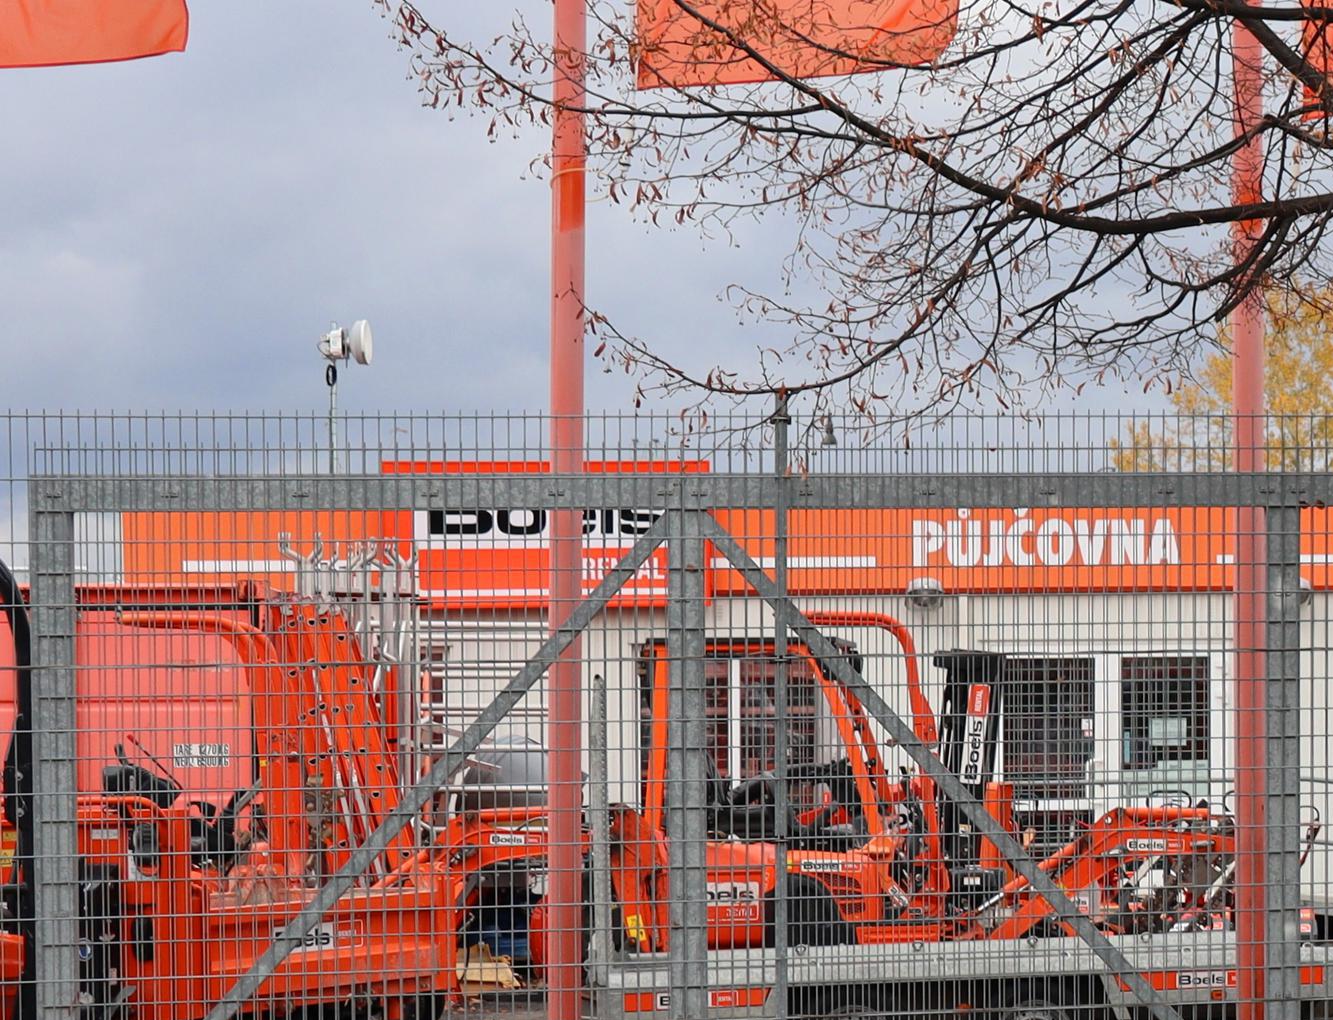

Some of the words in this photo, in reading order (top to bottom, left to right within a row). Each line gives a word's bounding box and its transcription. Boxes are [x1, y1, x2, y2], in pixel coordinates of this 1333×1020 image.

[912, 507, 1181, 566] PŮJČOVNA
[582, 557, 665, 580] RENAL
[964, 720, 983, 780] Boels
[1179, 973, 1225, 985] Boels
